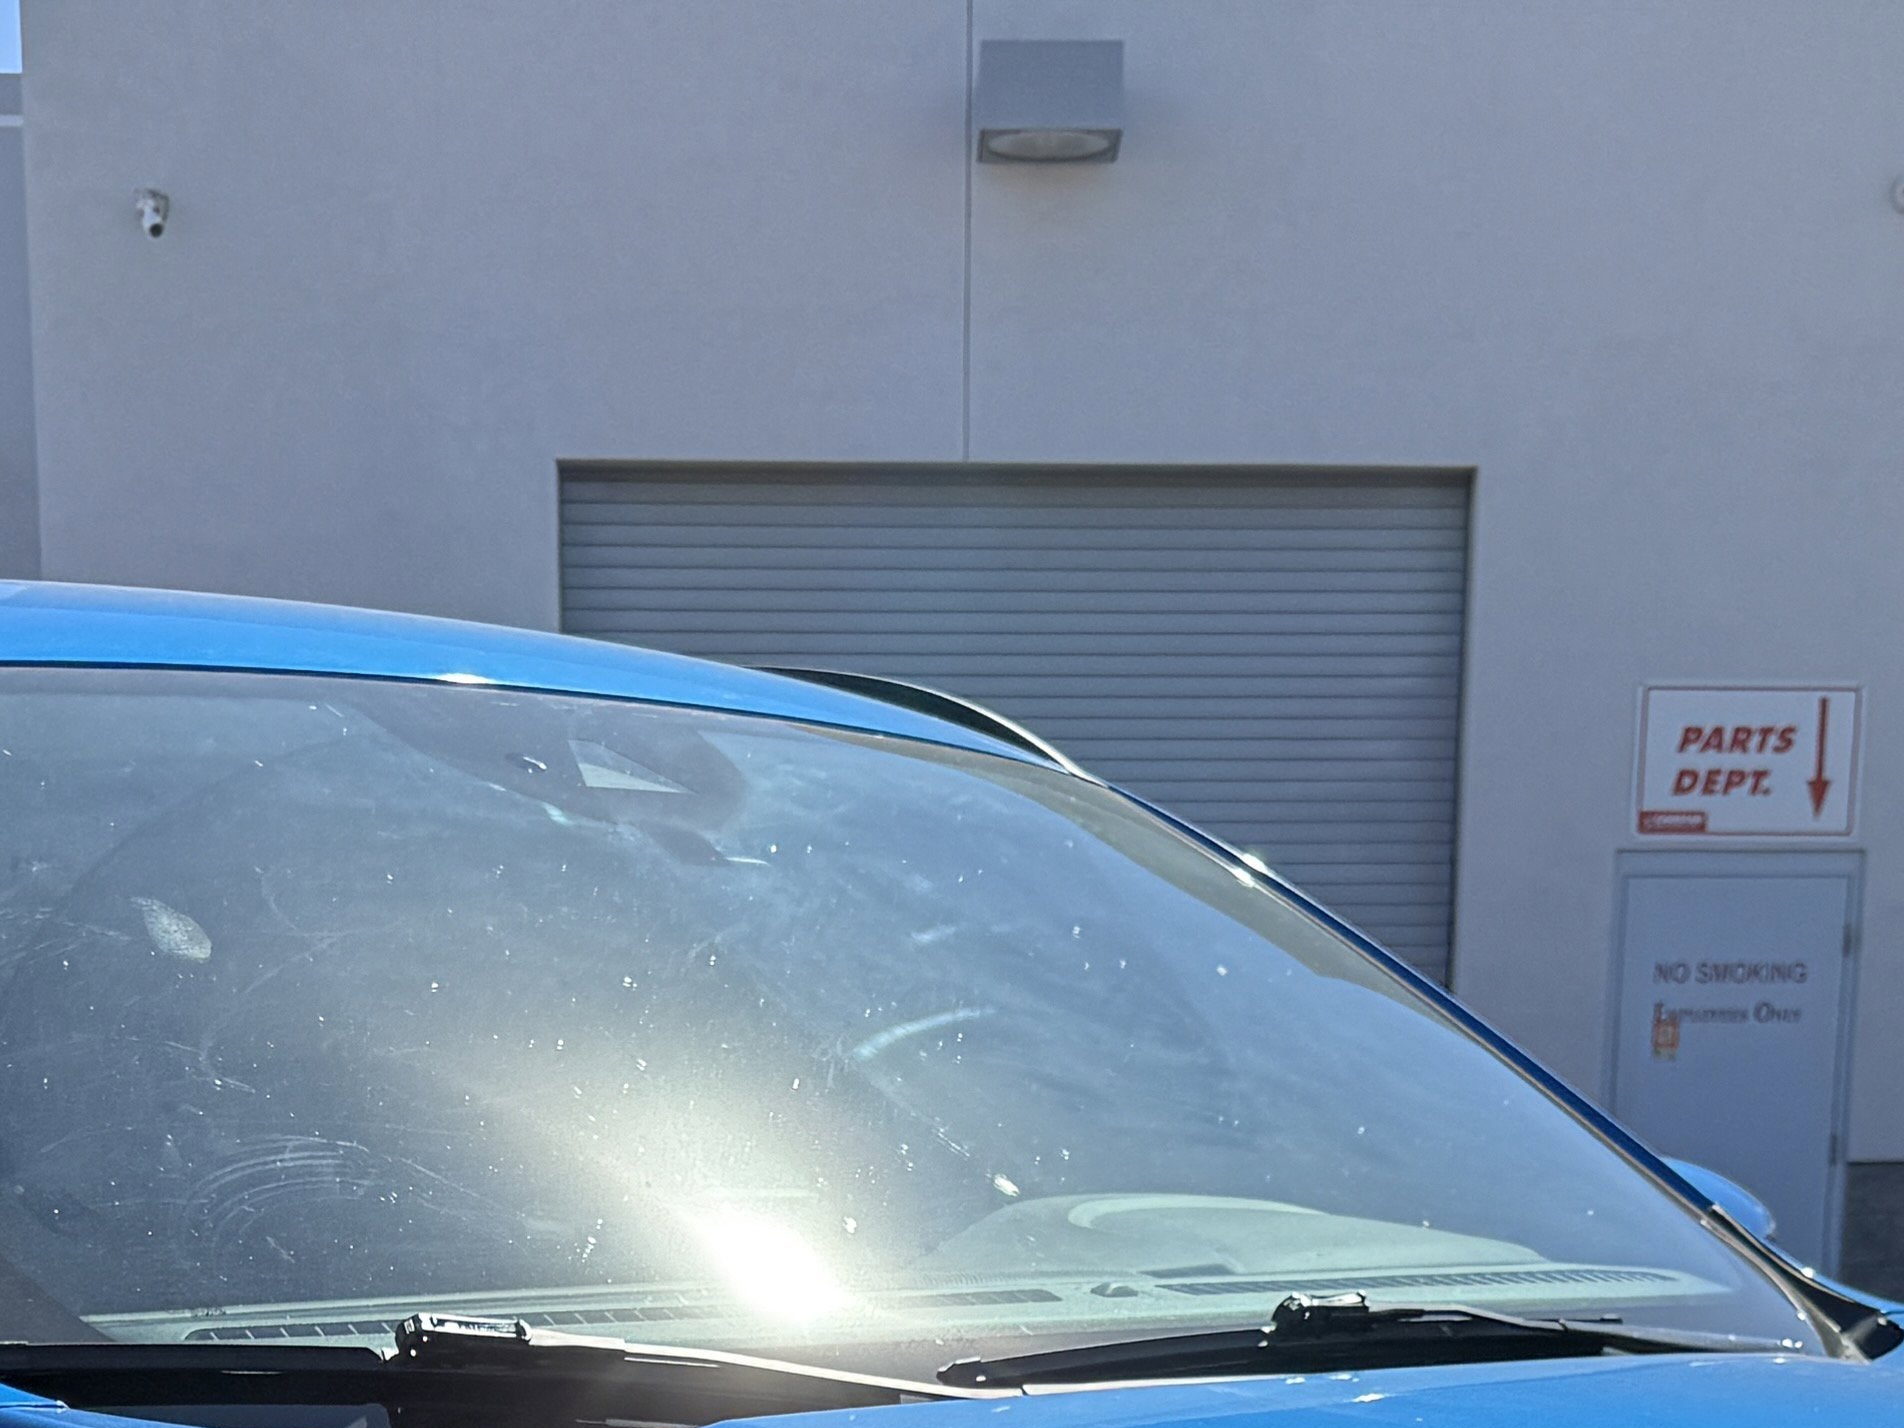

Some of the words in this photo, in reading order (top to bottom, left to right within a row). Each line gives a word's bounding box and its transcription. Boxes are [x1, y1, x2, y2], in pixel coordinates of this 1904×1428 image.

[1676, 725, 1797, 753] PARTS
[1672, 768, 1771, 796] DEPT.
[1653, 960, 1691, 984] NO
[1694, 960, 1808, 984] SMOKING
